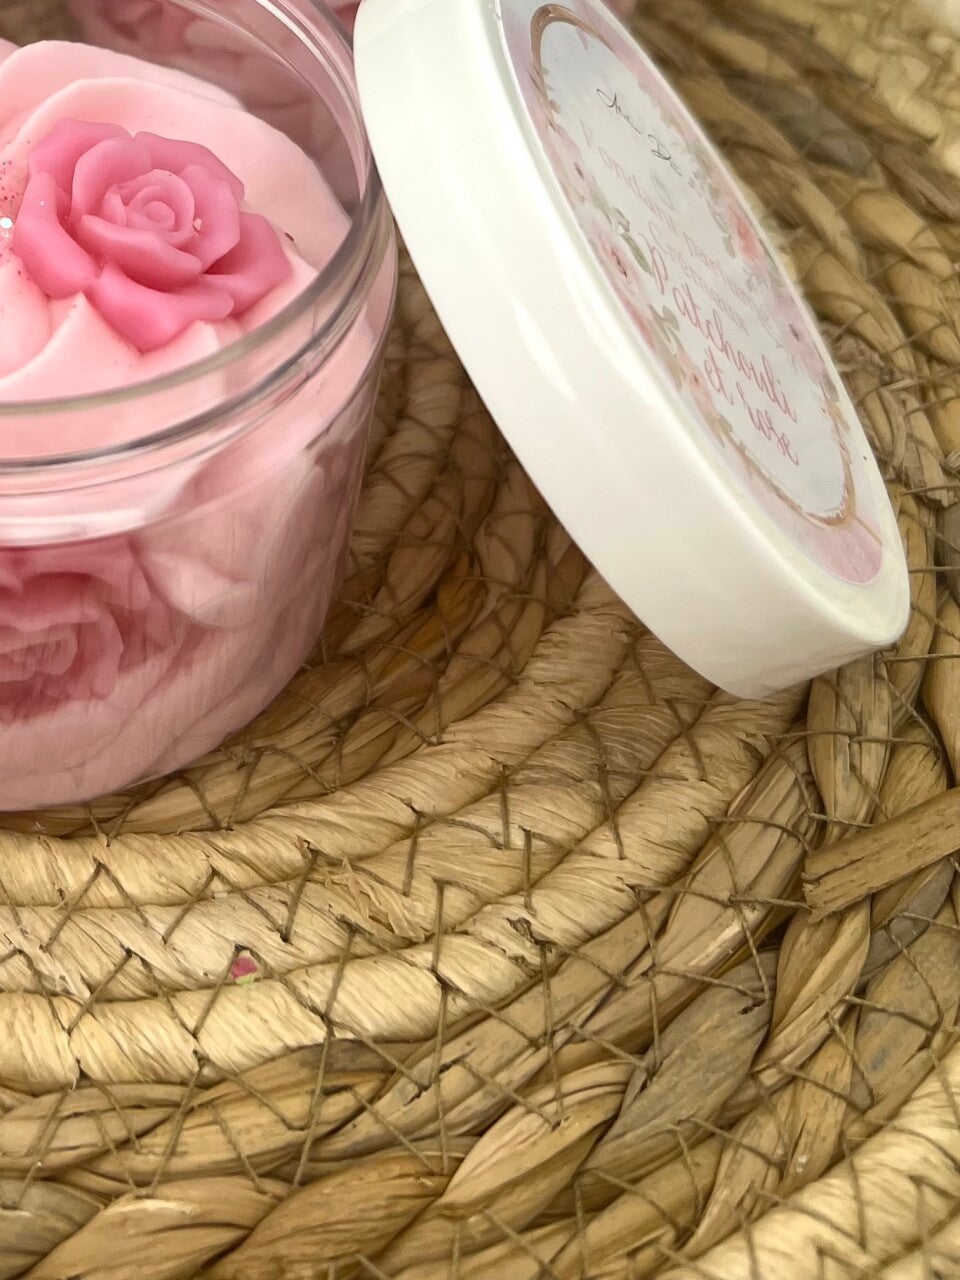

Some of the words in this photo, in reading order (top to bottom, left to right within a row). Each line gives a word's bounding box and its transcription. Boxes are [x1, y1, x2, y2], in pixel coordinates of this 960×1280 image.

[638, 232, 797, 423] Patchouli
[704, 344, 734, 406] et
[736, 381, 798, 466] rose
